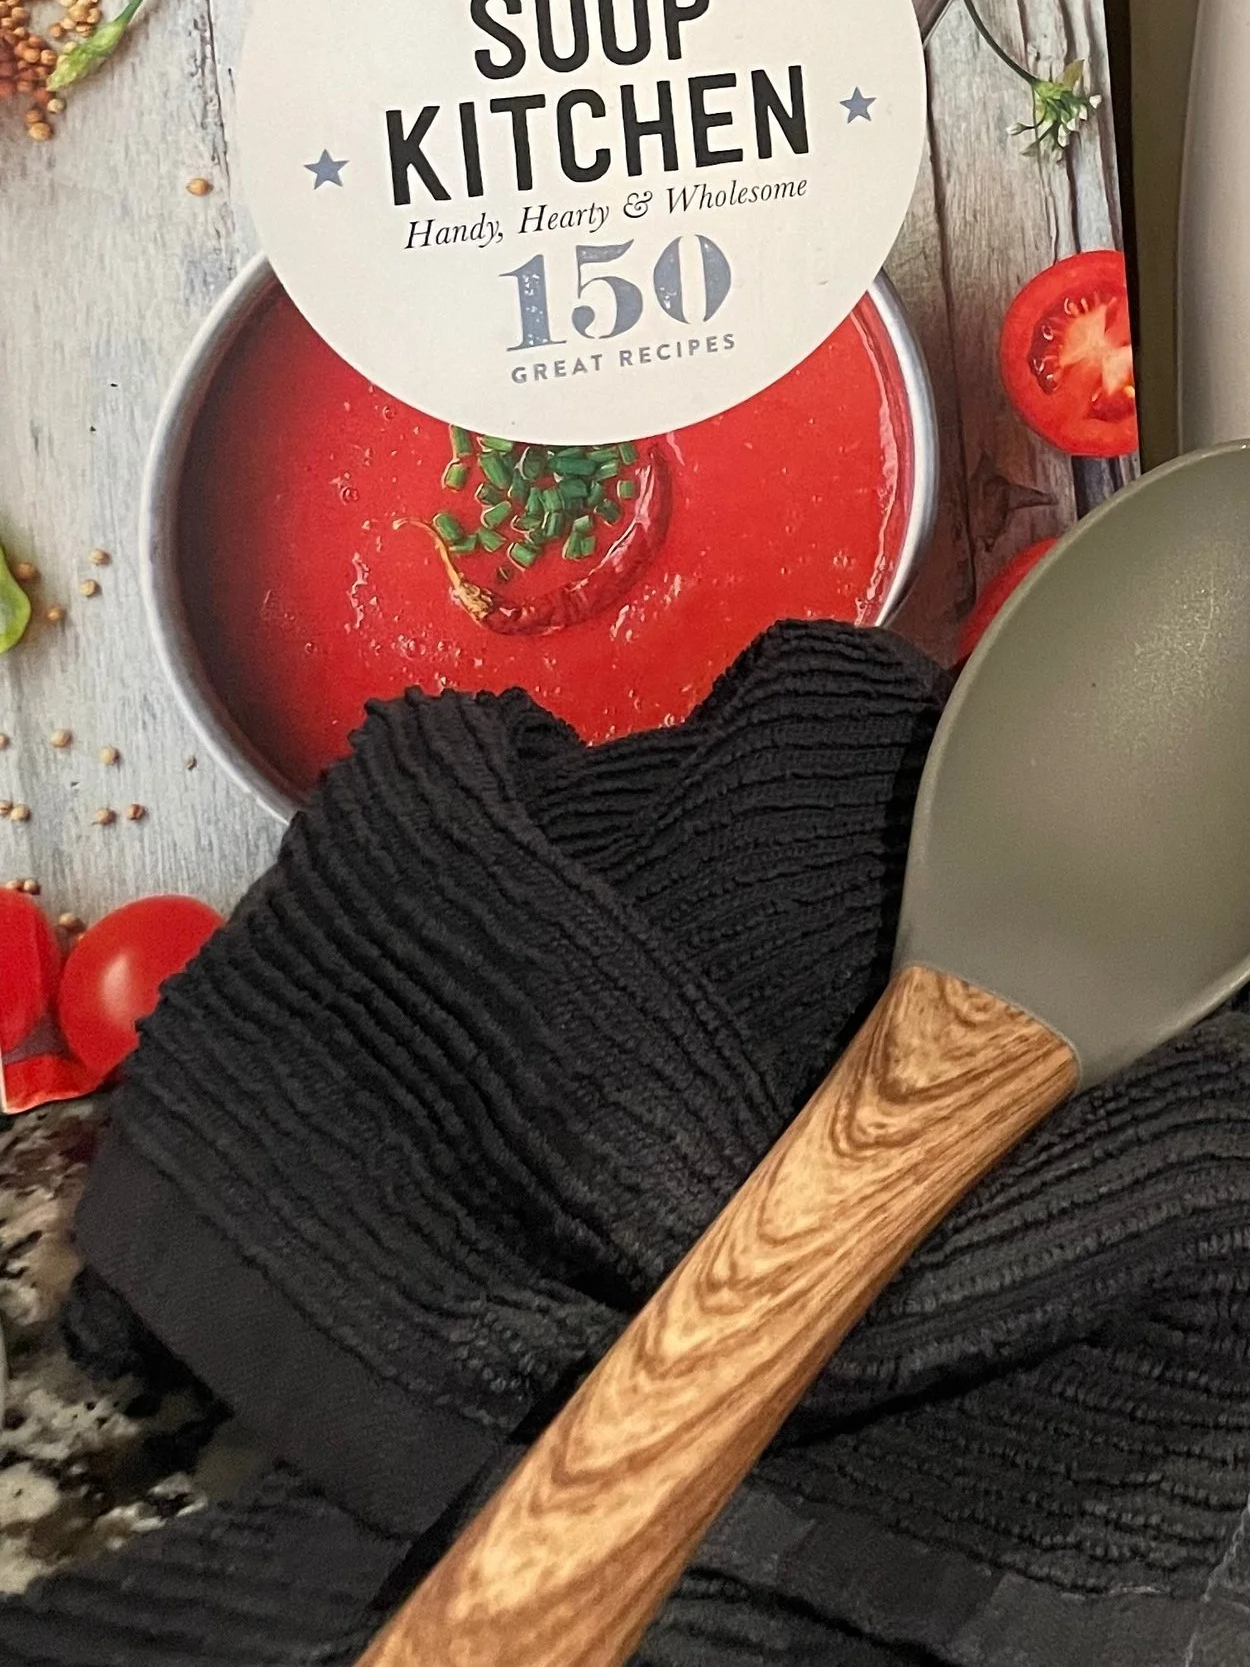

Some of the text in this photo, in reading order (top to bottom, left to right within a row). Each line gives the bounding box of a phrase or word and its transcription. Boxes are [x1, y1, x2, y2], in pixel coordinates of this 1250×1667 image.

[385, 65, 809, 205] KITCHEN
[404, 177, 807, 249] Handy, Hearty & Wholesome
[499, 234, 732, 352] 150
[511, 333, 736, 384] GREAT RECIPES
